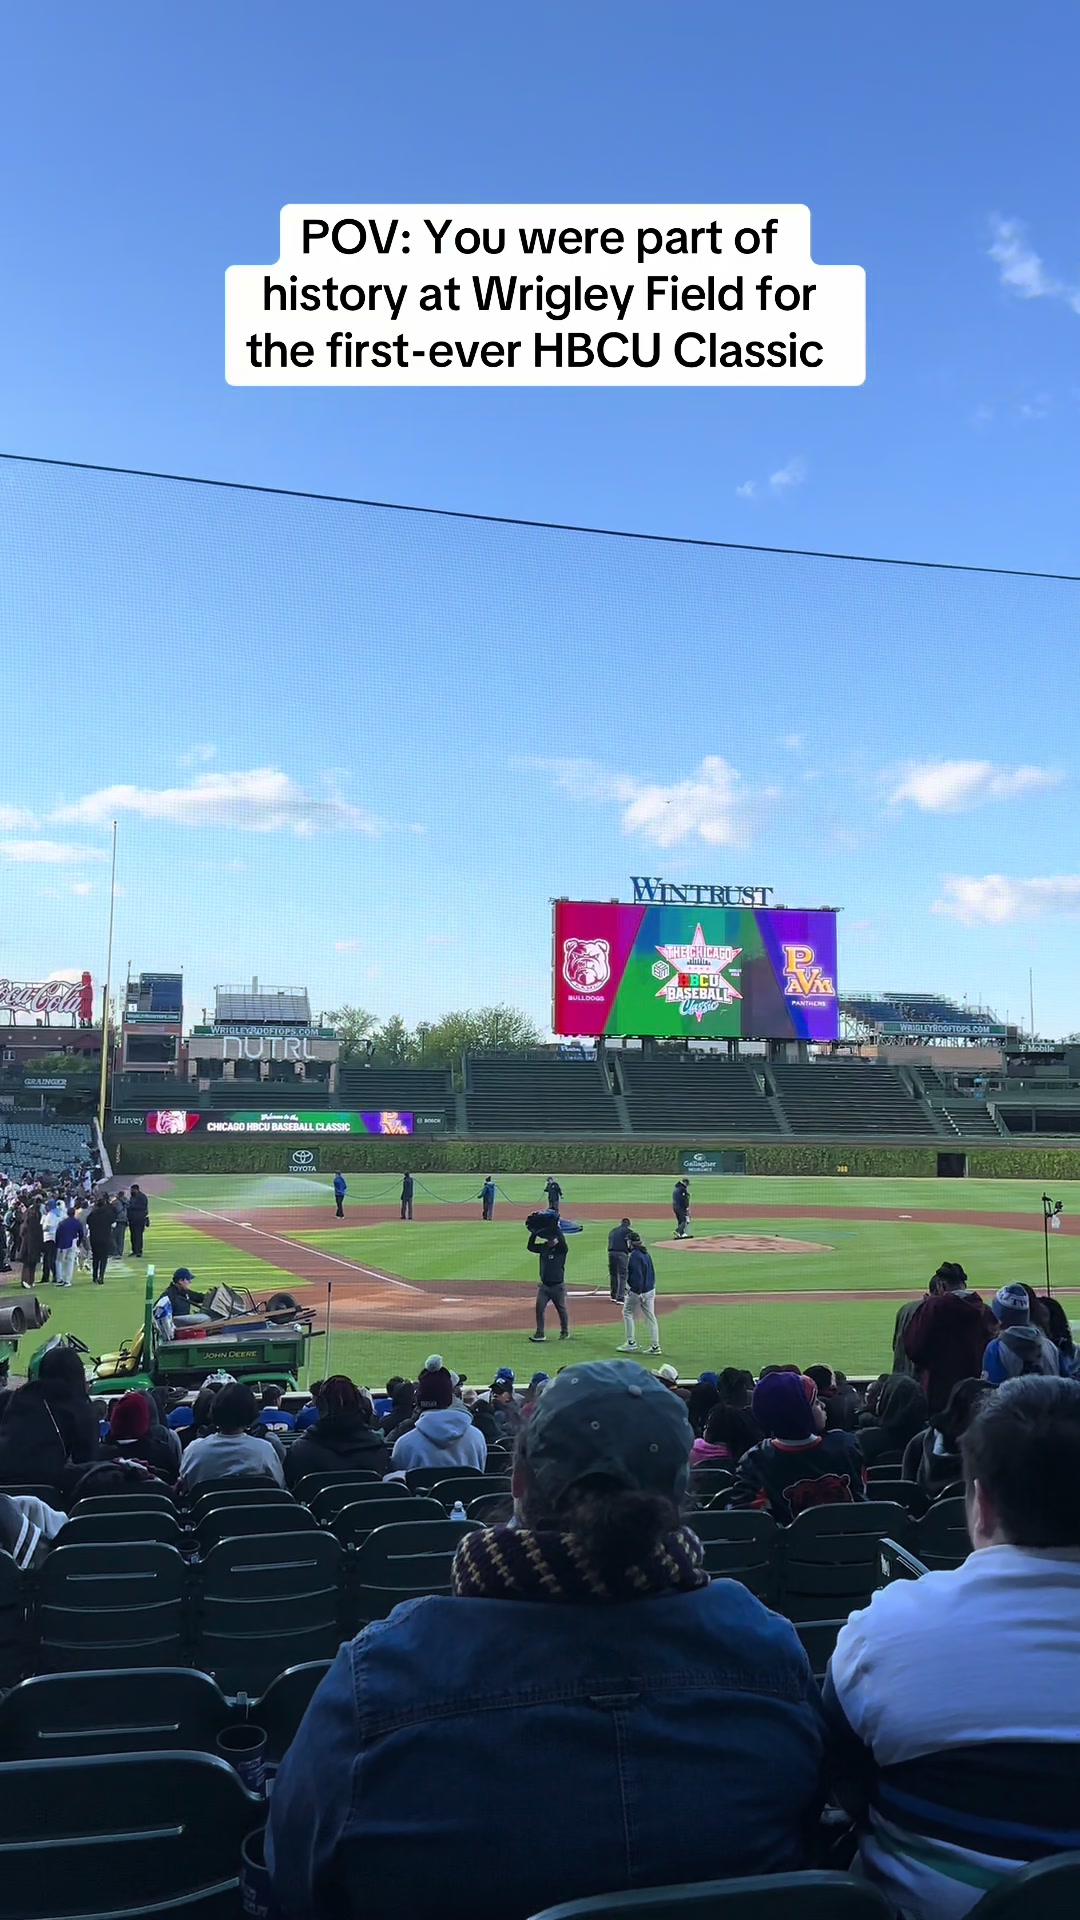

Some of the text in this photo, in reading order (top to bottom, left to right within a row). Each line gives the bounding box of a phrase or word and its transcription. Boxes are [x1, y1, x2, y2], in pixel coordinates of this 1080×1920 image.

[666, 946, 731, 960] THE CHICAGO
[678, 973, 719, 988] HBCU
[567, 994, 605, 1002] BULLDOGS
[667, 986, 730, 1001] BASEBALL
[223, 1036, 316, 1059] NUTRL
[113, 1116, 144, 1126] Harvey
[207, 1122, 350, 1132] CHICAGO HBCU BASEBALL CLASSIC
[228, 1350, 258, 1358] DEERE
